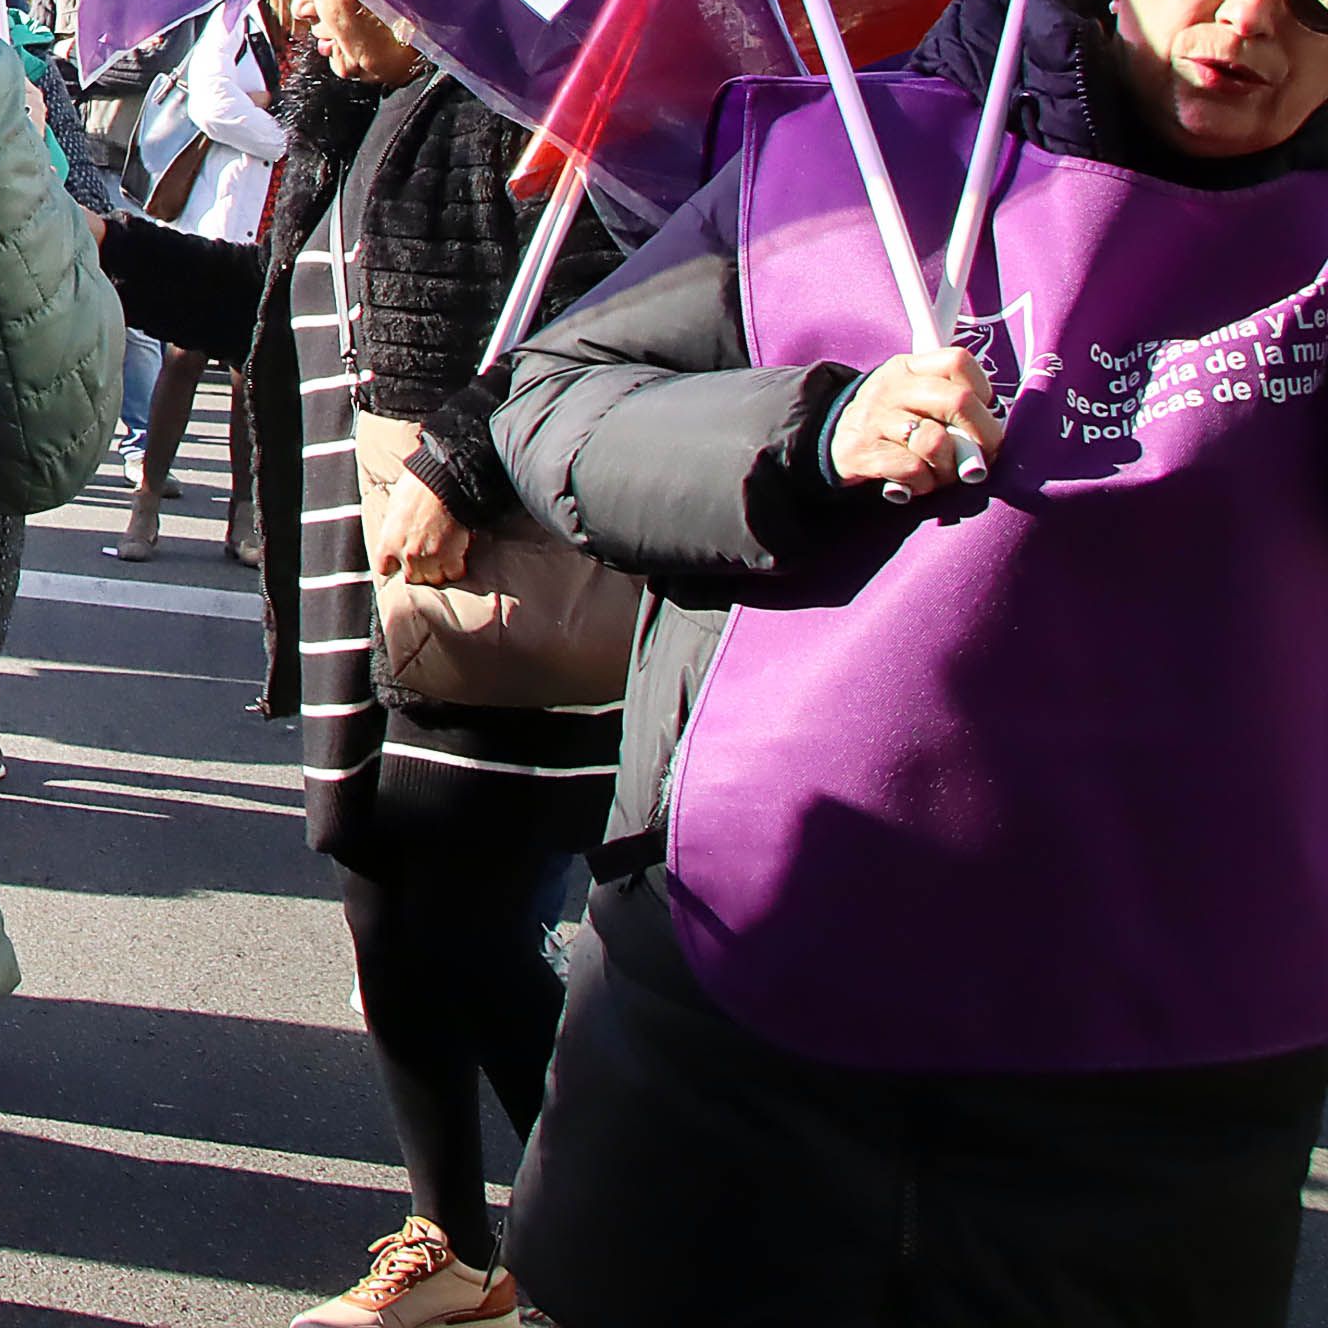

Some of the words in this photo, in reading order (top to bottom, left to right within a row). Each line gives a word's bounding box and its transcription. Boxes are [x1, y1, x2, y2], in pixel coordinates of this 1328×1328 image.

[1109, 370, 1140, 394] de
[1265, 312, 1285, 339] y
[1205, 349, 1247, 374] de
[1253, 342, 1285, 367] la
[1060, 415, 1075, 439] y
[1212, 378, 1252, 404] de
